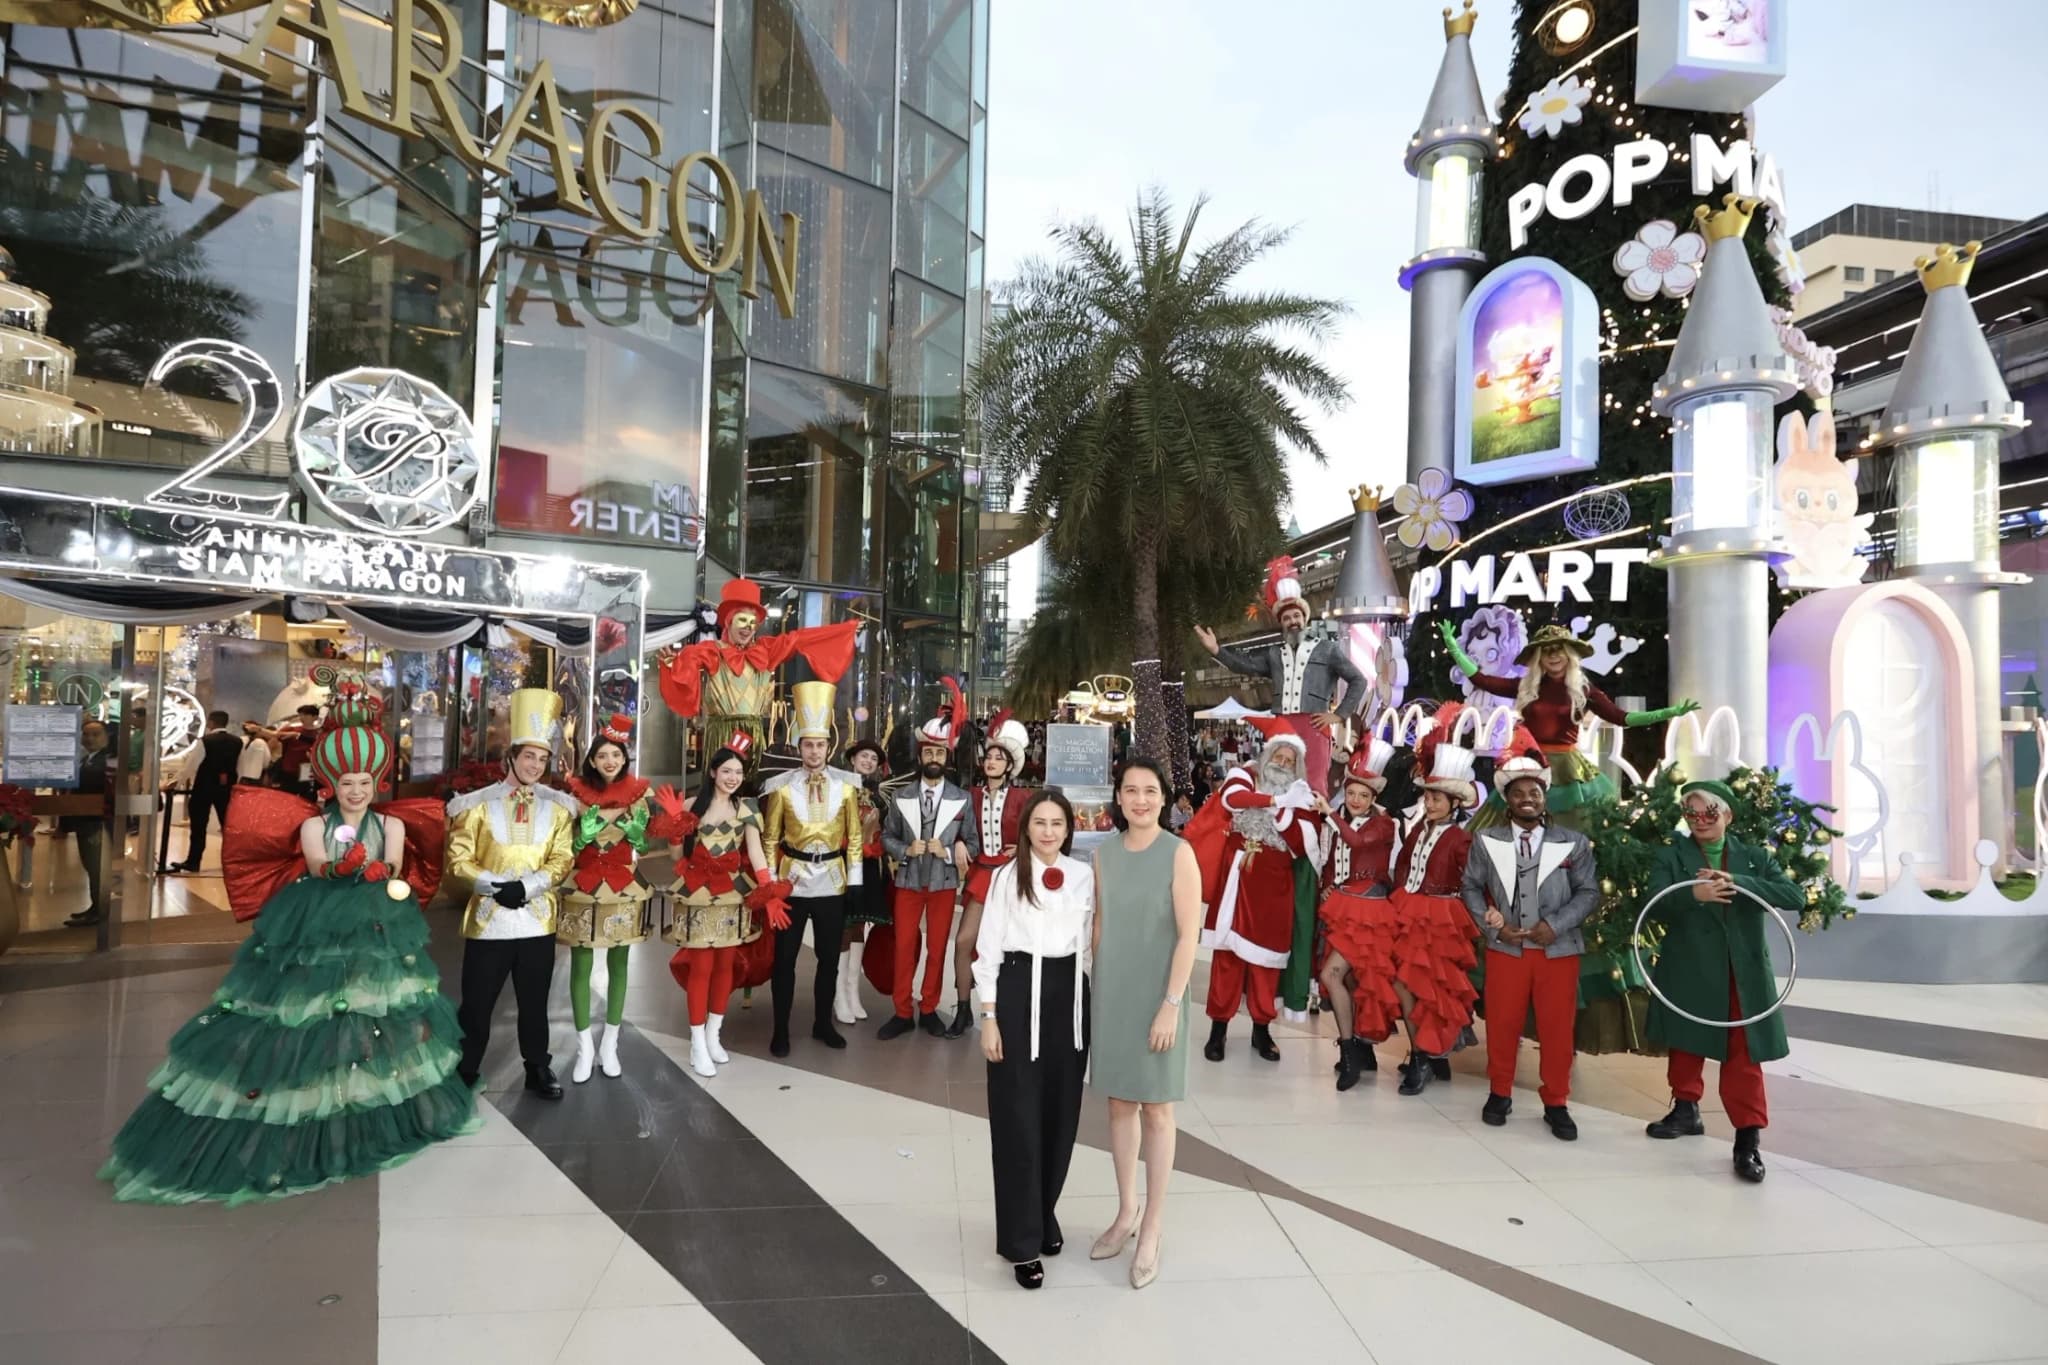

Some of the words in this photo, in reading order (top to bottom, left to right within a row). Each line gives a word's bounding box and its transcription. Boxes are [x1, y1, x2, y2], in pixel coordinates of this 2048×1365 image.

[1508, 138, 1672, 251] POP
[177, 546, 283, 582] SIAM
[302, 560, 466, 597] PARAGON
[1450, 548, 1649, 608] MART
[66, 683, 93, 705] IN
